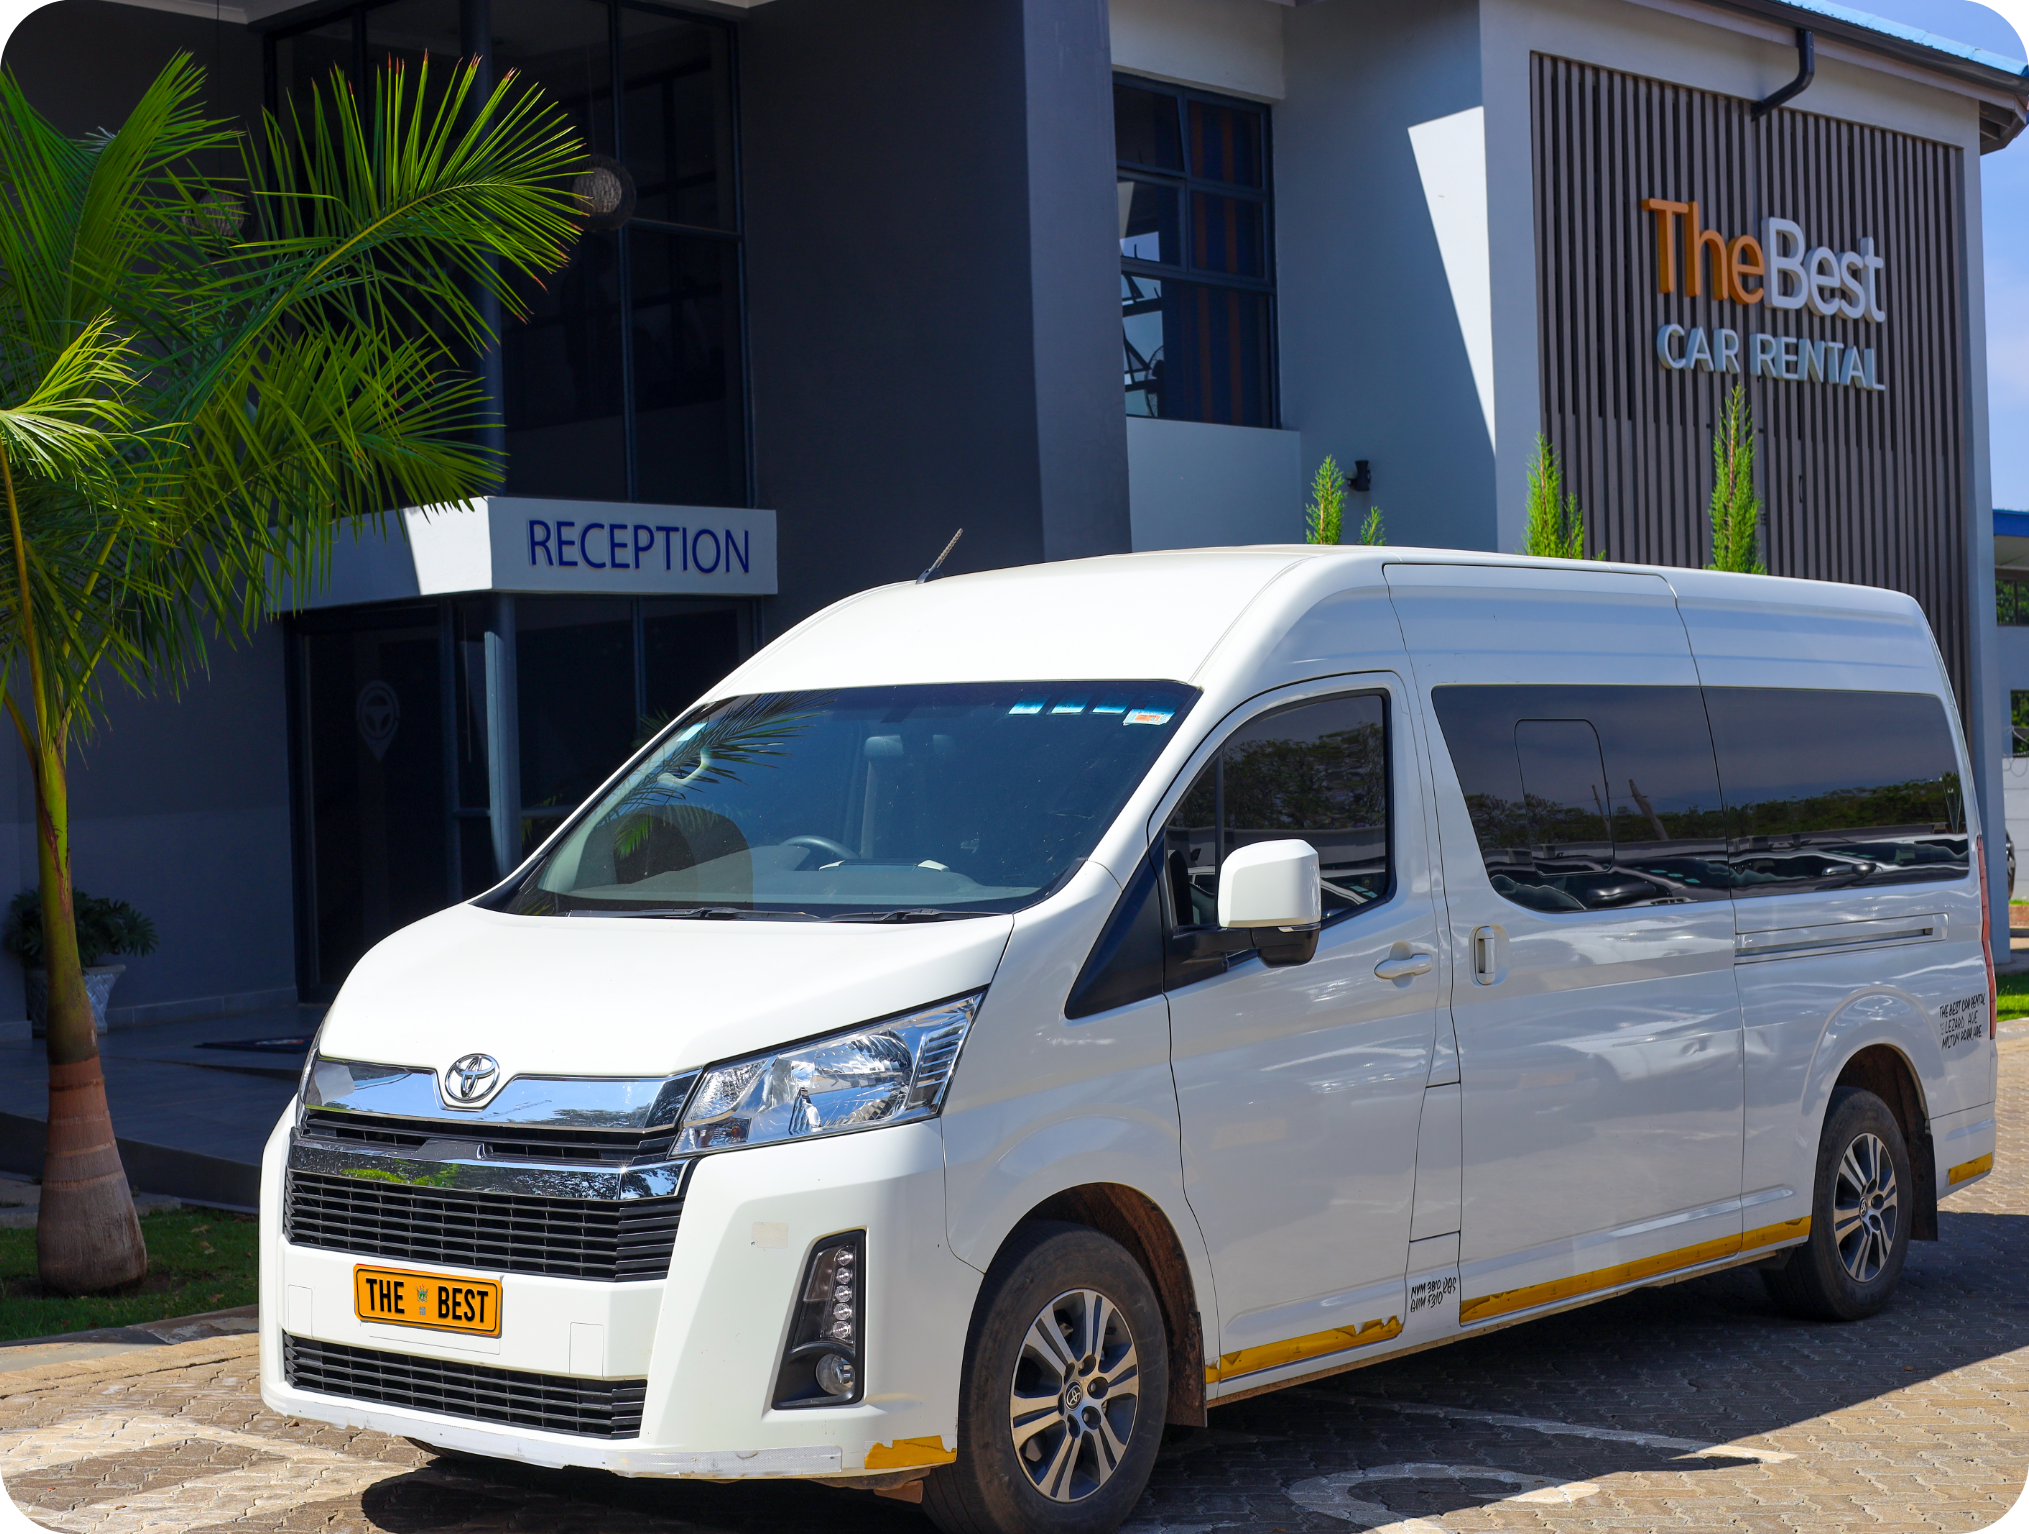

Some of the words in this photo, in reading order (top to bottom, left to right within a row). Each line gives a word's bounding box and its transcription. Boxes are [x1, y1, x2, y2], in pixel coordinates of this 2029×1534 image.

[1657, 323, 1741, 374] CAR
[1750, 333, 1886, 391] RENTAL
[527, 519, 750, 574] RECEPTION
[366, 1277, 405, 1314] THE
[438, 1285, 489, 1323] BEST
